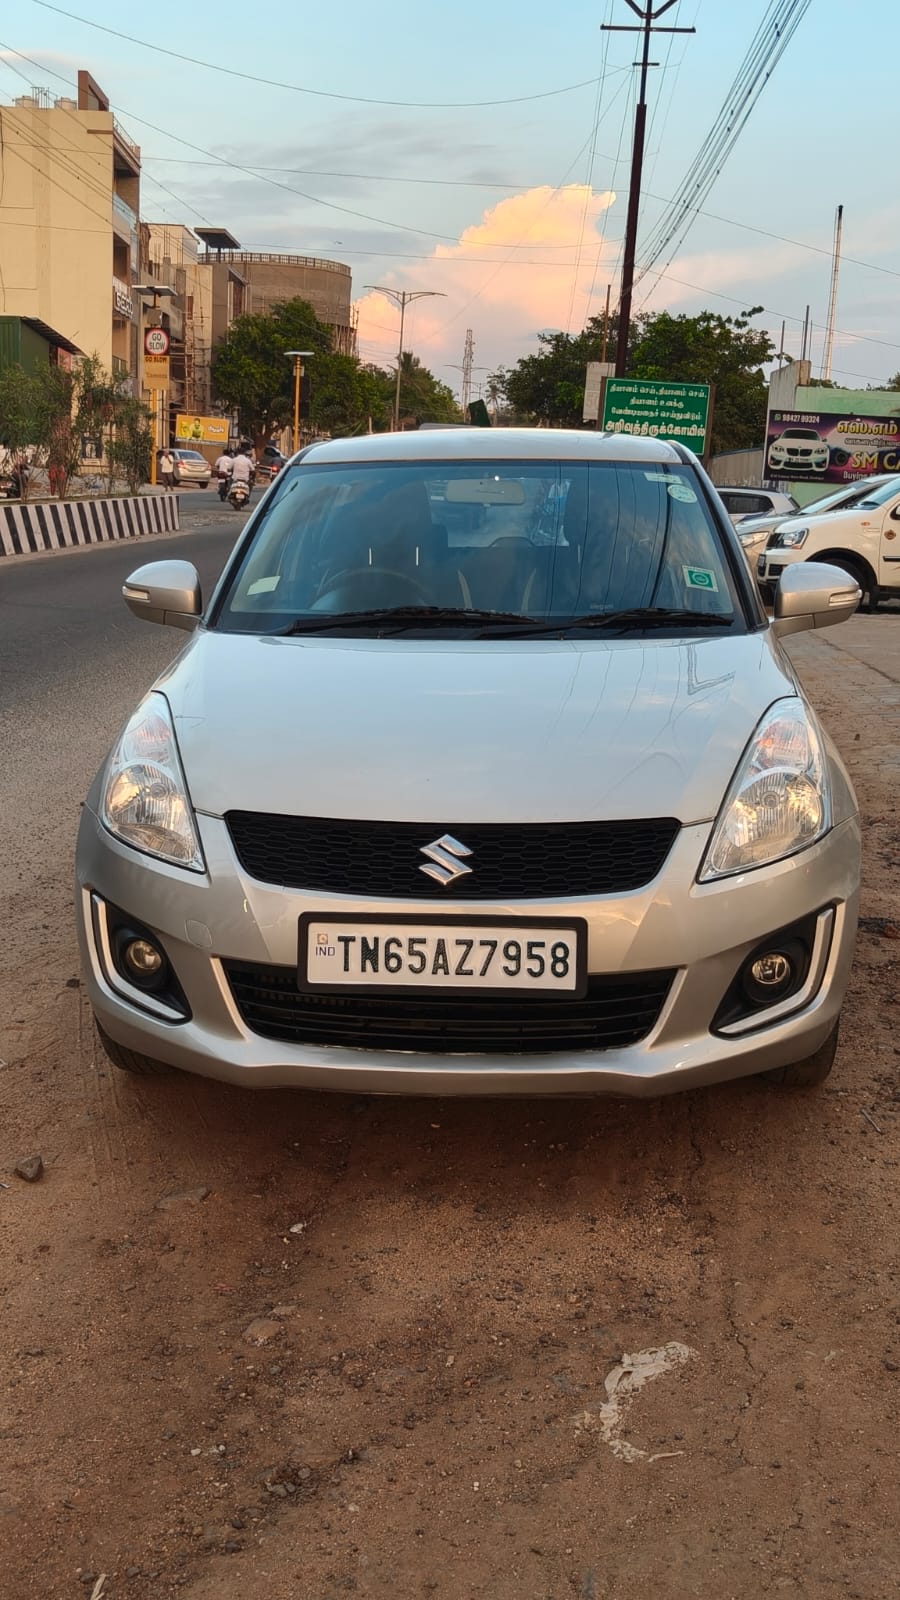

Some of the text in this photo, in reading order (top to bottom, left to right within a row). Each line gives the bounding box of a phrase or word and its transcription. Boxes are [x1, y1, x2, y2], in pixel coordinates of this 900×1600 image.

[152, 333, 161, 341] GO
[149, 342, 165, 350] SLOW
[852, 451, 880, 470] SM
[315, 946, 336, 957] IND
[337, 935, 570, 978] TN65AZ7958
